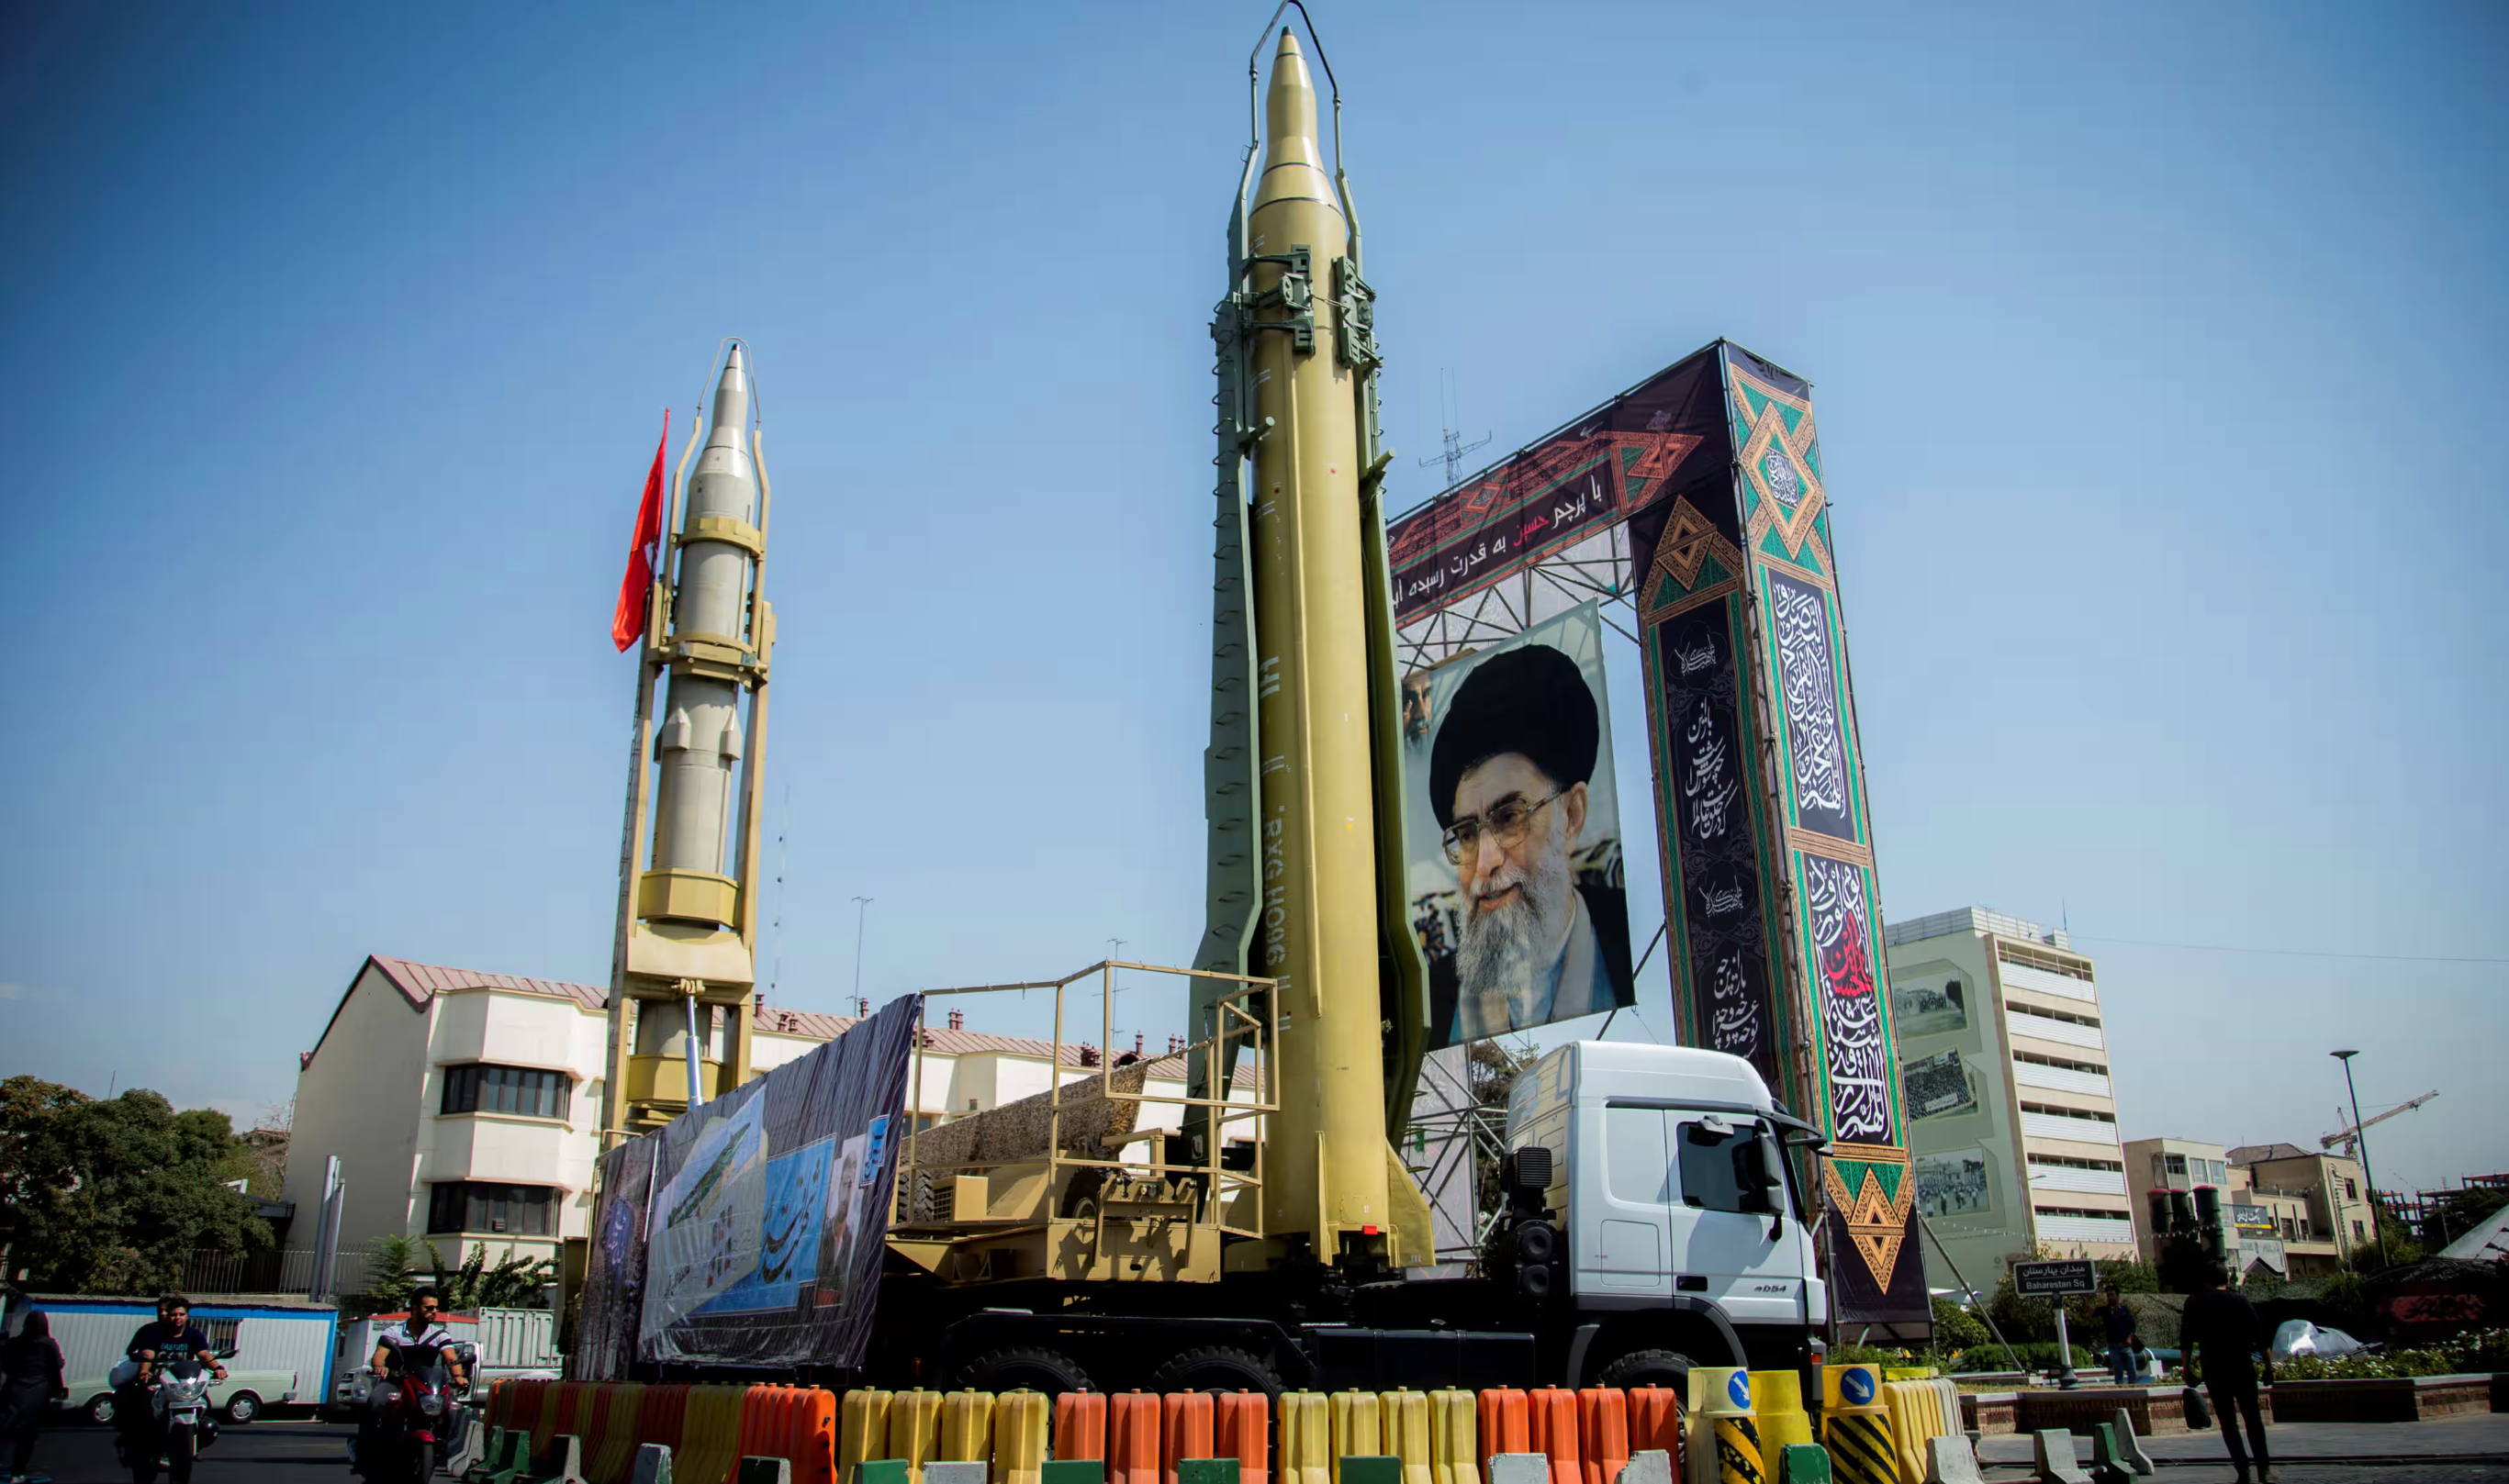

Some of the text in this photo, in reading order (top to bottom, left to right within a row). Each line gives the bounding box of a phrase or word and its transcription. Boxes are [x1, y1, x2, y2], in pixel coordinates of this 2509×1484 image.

[1590, 474, 1602, 502] با
[1551, 494, 1585, 530] پرچم
[1493, 535, 1507, 554] به
[1513, 515, 1550, 547] حسین
[1451, 542, 1487, 577] قدرت
[1408, 568, 1445, 597] رسیده
[2060, 1264, 2086, 1275] میدان
[2026, 1278, 2086, 1290] Baharestan Sq
